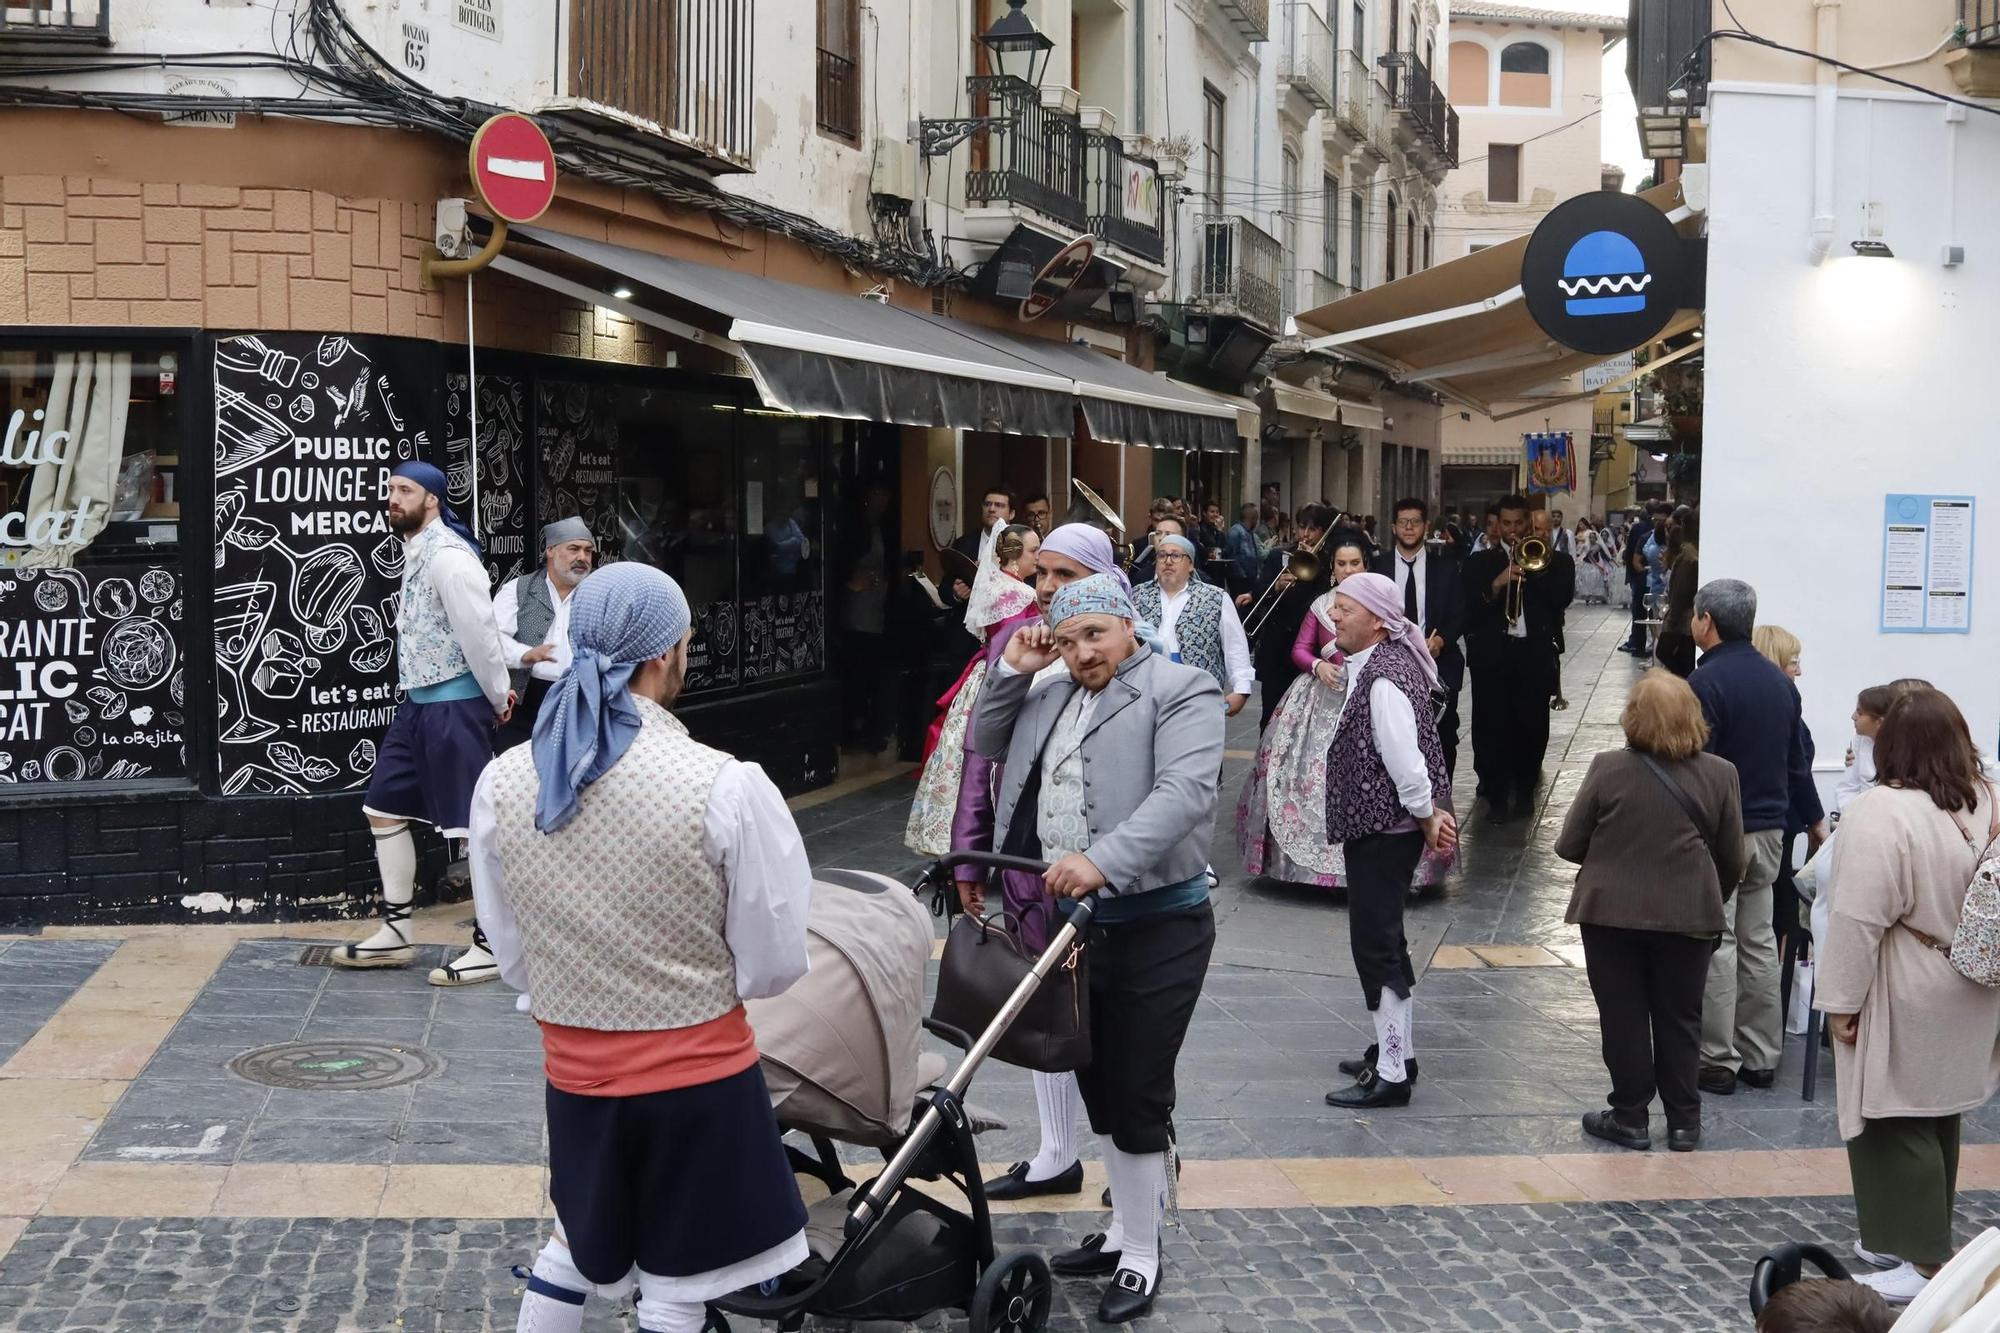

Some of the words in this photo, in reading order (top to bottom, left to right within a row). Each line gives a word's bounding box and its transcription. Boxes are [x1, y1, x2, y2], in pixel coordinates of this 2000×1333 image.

[459, 5, 495, 34] BOTIGUES
[402, 23, 429, 44] MANZANA
[405, 40, 425, 71] 65
[0, 409, 70, 465] lic
[295, 437, 391, 460] PUBLIC
[579, 452, 597, 465] let's
[598, 454, 612, 466] eat
[575, 470, 614, 484] RESTAURANTE
[0, 496, 94, 546] cat
[291, 511, 393, 535] MERCA
[491, 535, 524, 554] MOJITOS
[311, 684, 358, 705] let's
[362, 682, 391, 701] eat
[301, 705, 398, 733] RESTAURANTE
